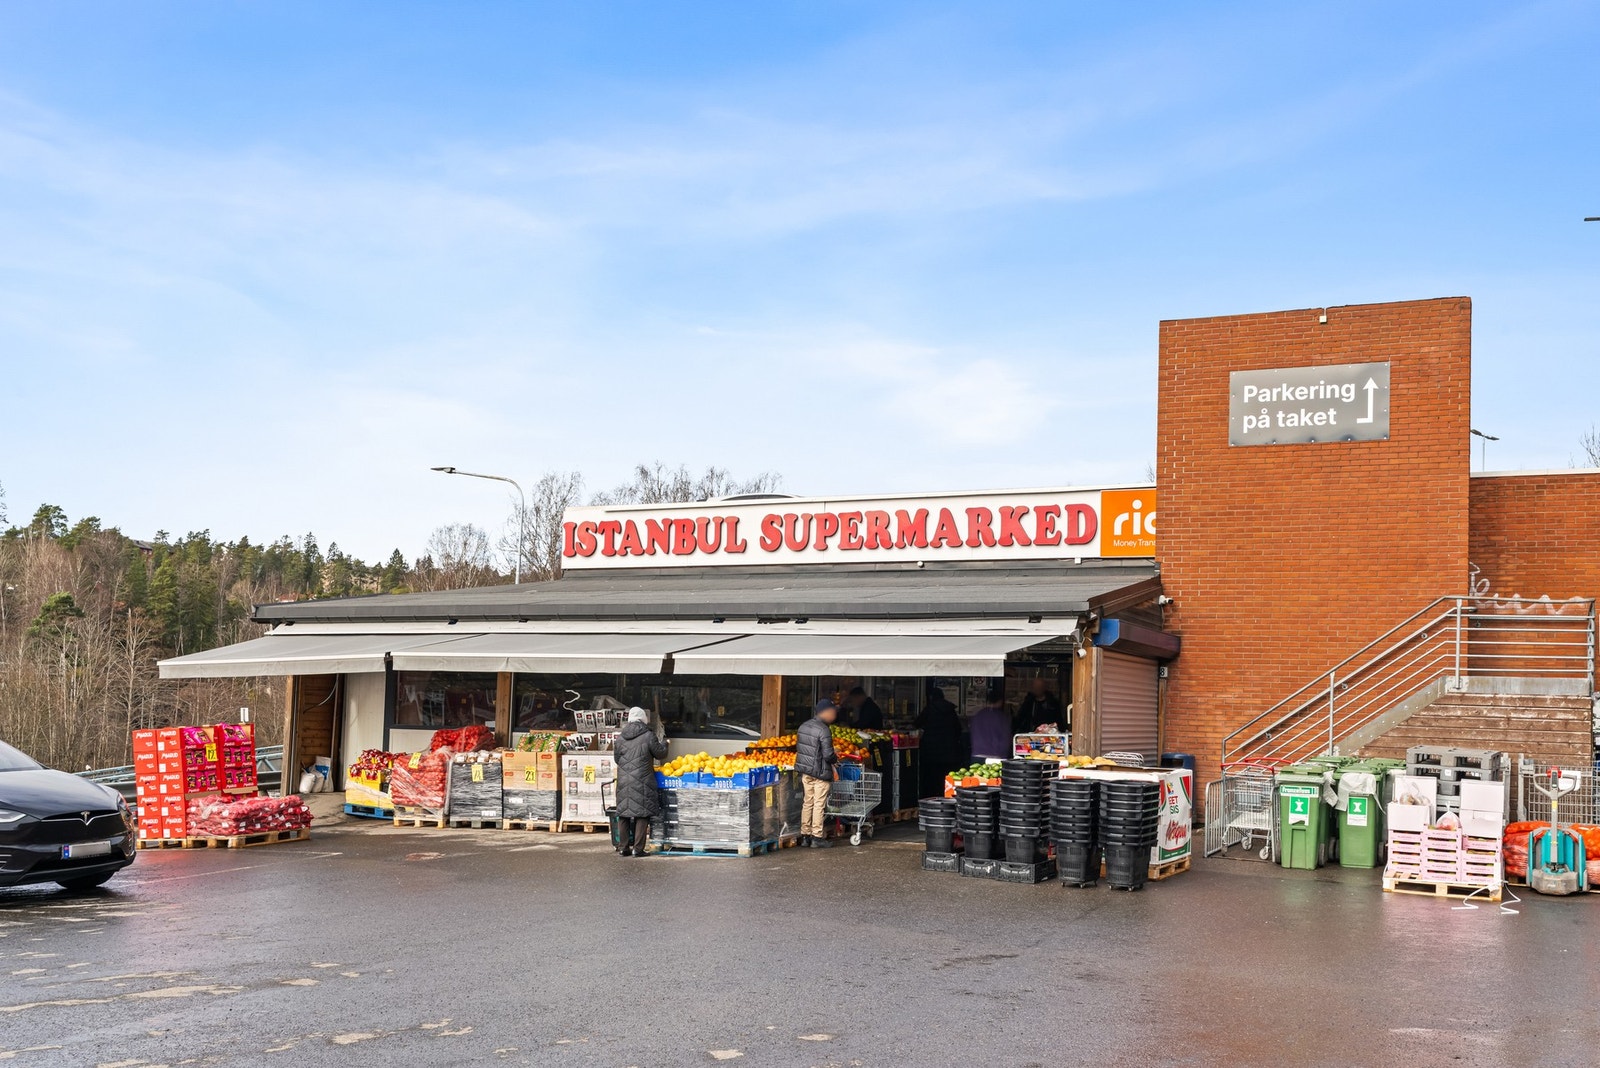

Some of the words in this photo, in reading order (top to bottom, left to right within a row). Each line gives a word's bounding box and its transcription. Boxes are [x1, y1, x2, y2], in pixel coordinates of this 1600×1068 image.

[1243, 381, 1355, 404] Parkering
[1243, 408, 1270, 433] på
[1277, 408, 1337, 427] taket
[562, 515, 746, 557] ISTANBUL
[760, 504, 1098, 552] SUPERMARKED
[1113, 540, 1137, 548] Money
